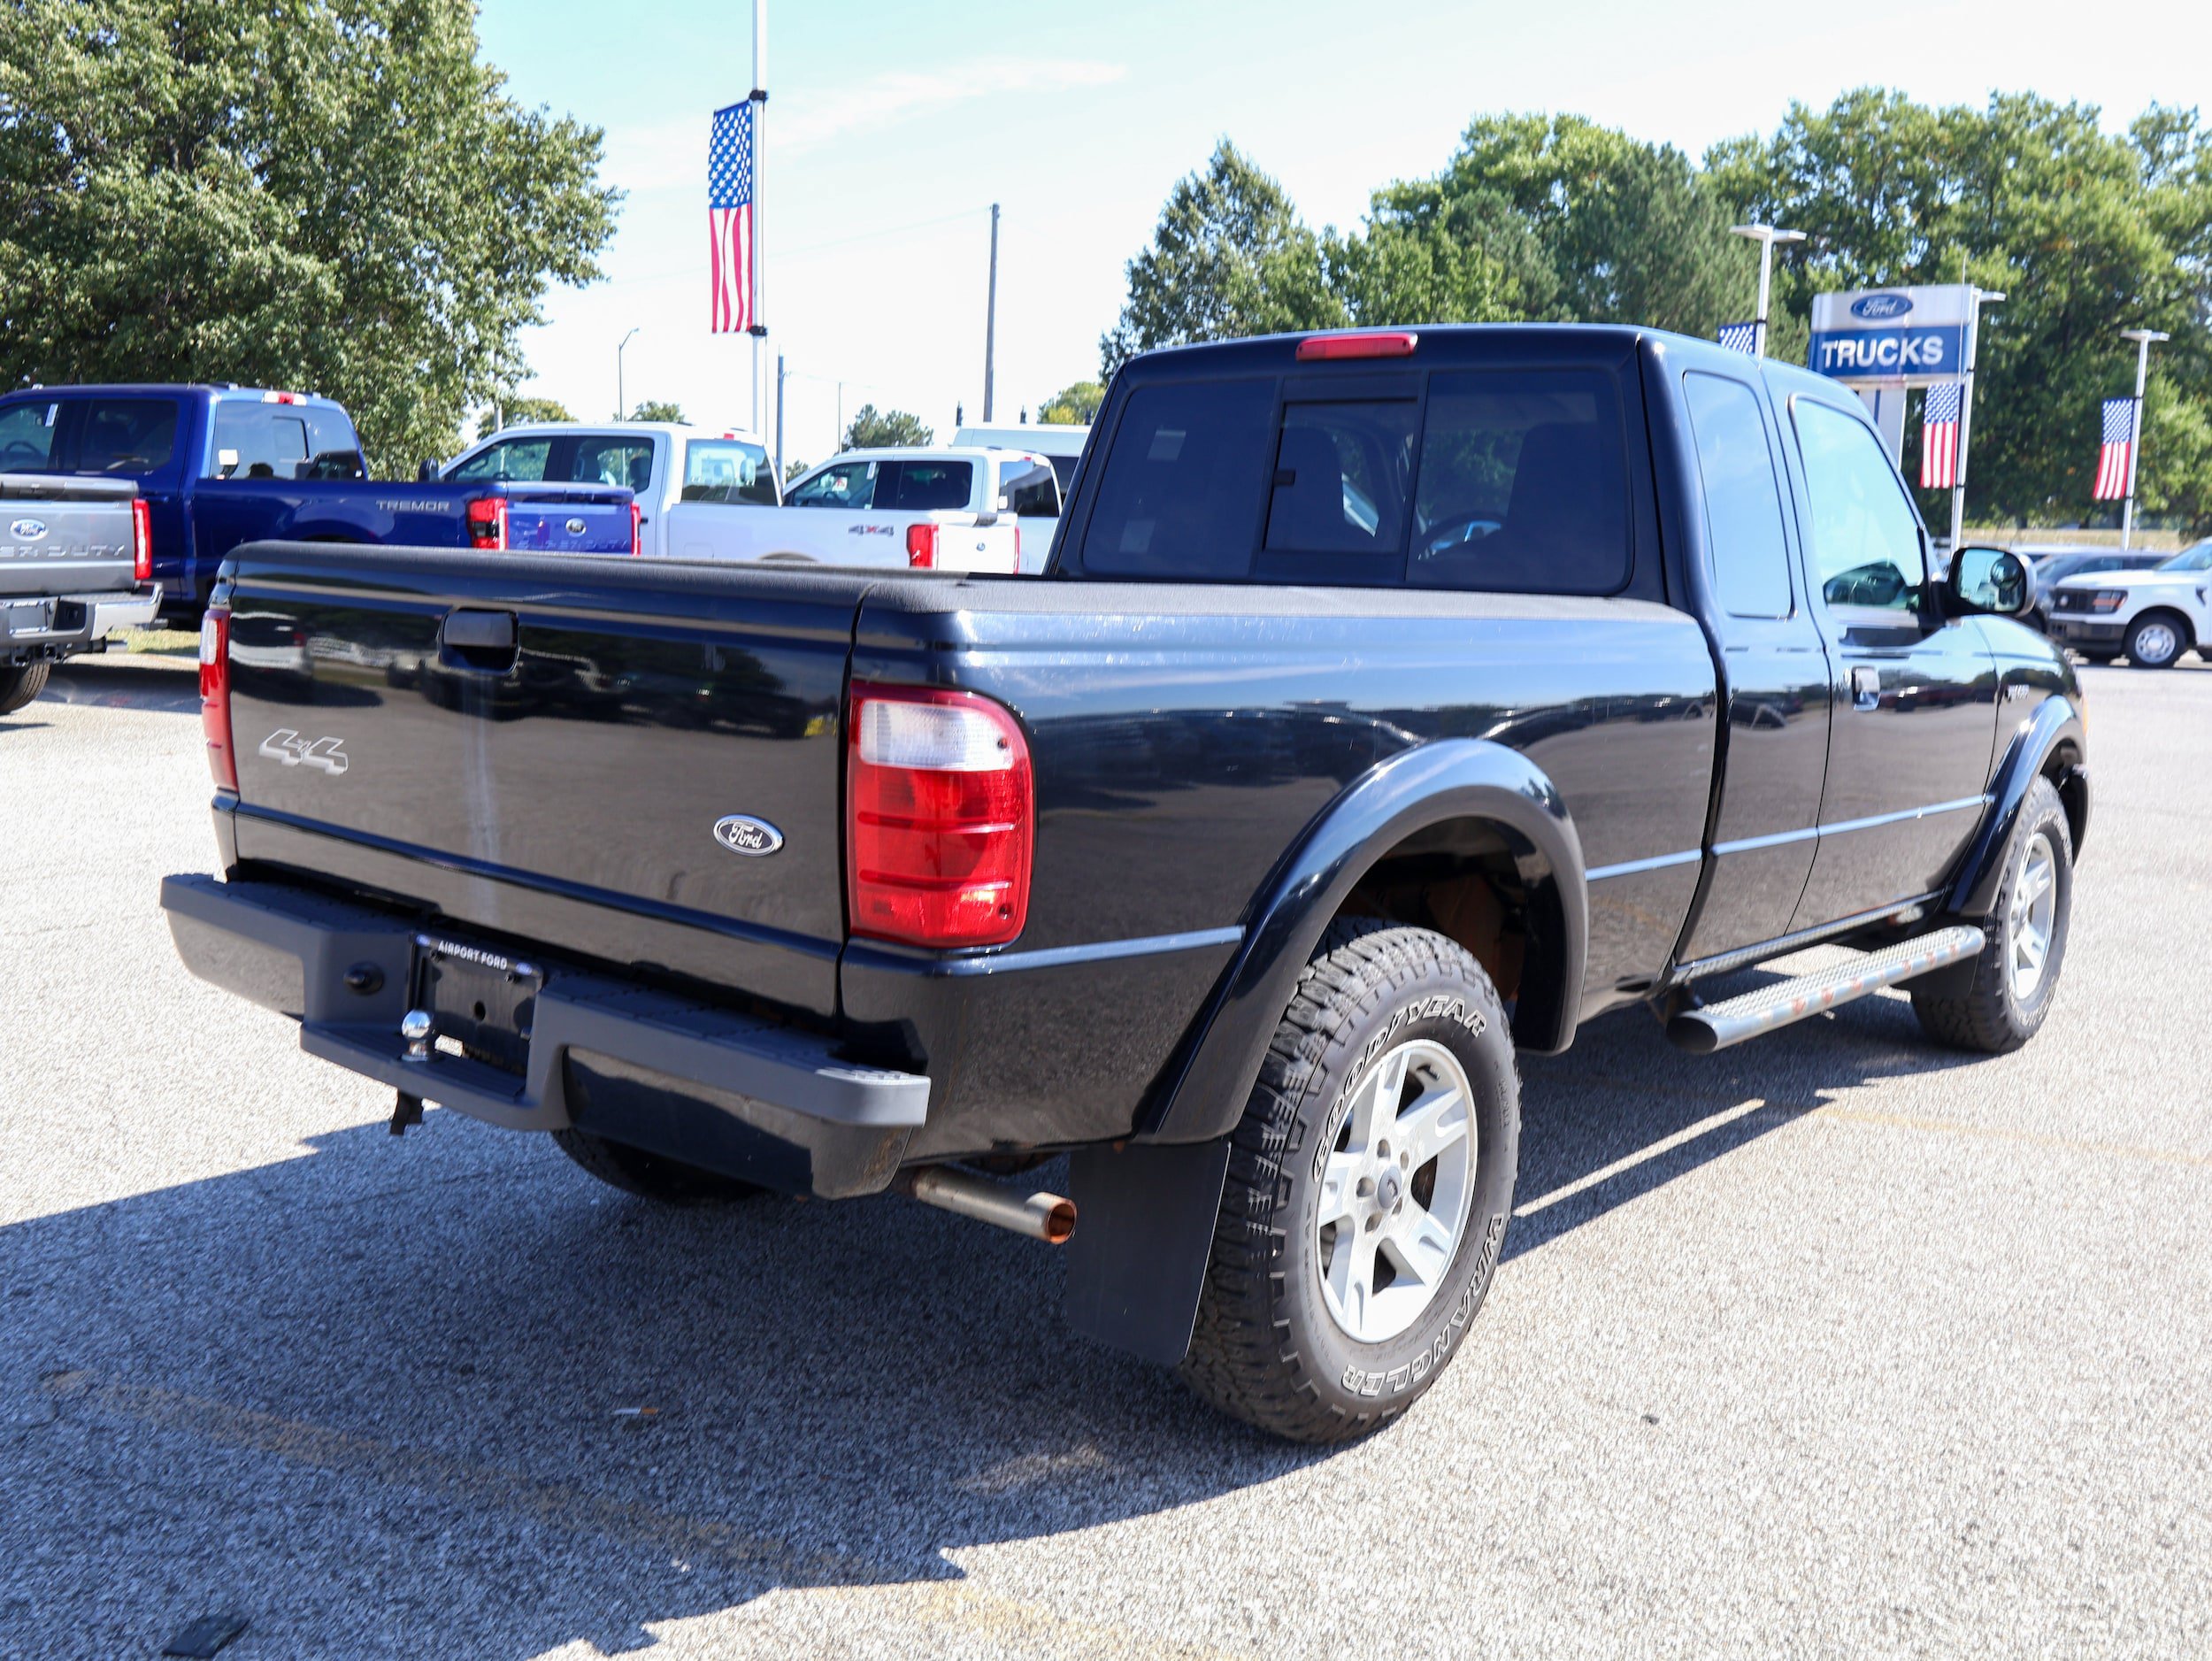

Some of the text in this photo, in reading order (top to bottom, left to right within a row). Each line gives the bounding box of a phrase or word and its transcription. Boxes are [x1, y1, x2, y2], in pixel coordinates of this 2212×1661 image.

[1862, 297, 1898, 317] Ford
[1821, 335, 1945, 369] TRUCKS
[375, 499, 450, 511] TREMOR
[48, 544, 126, 558] DUTY
[728, 821, 764, 850] Ford
[437, 940, 480, 963] AIRPORT
[480, 951, 508, 971] FORD
[1312, 995, 1487, 1183] GOODYEAR
[1341, 1212, 1505, 1396] WRANGLER
